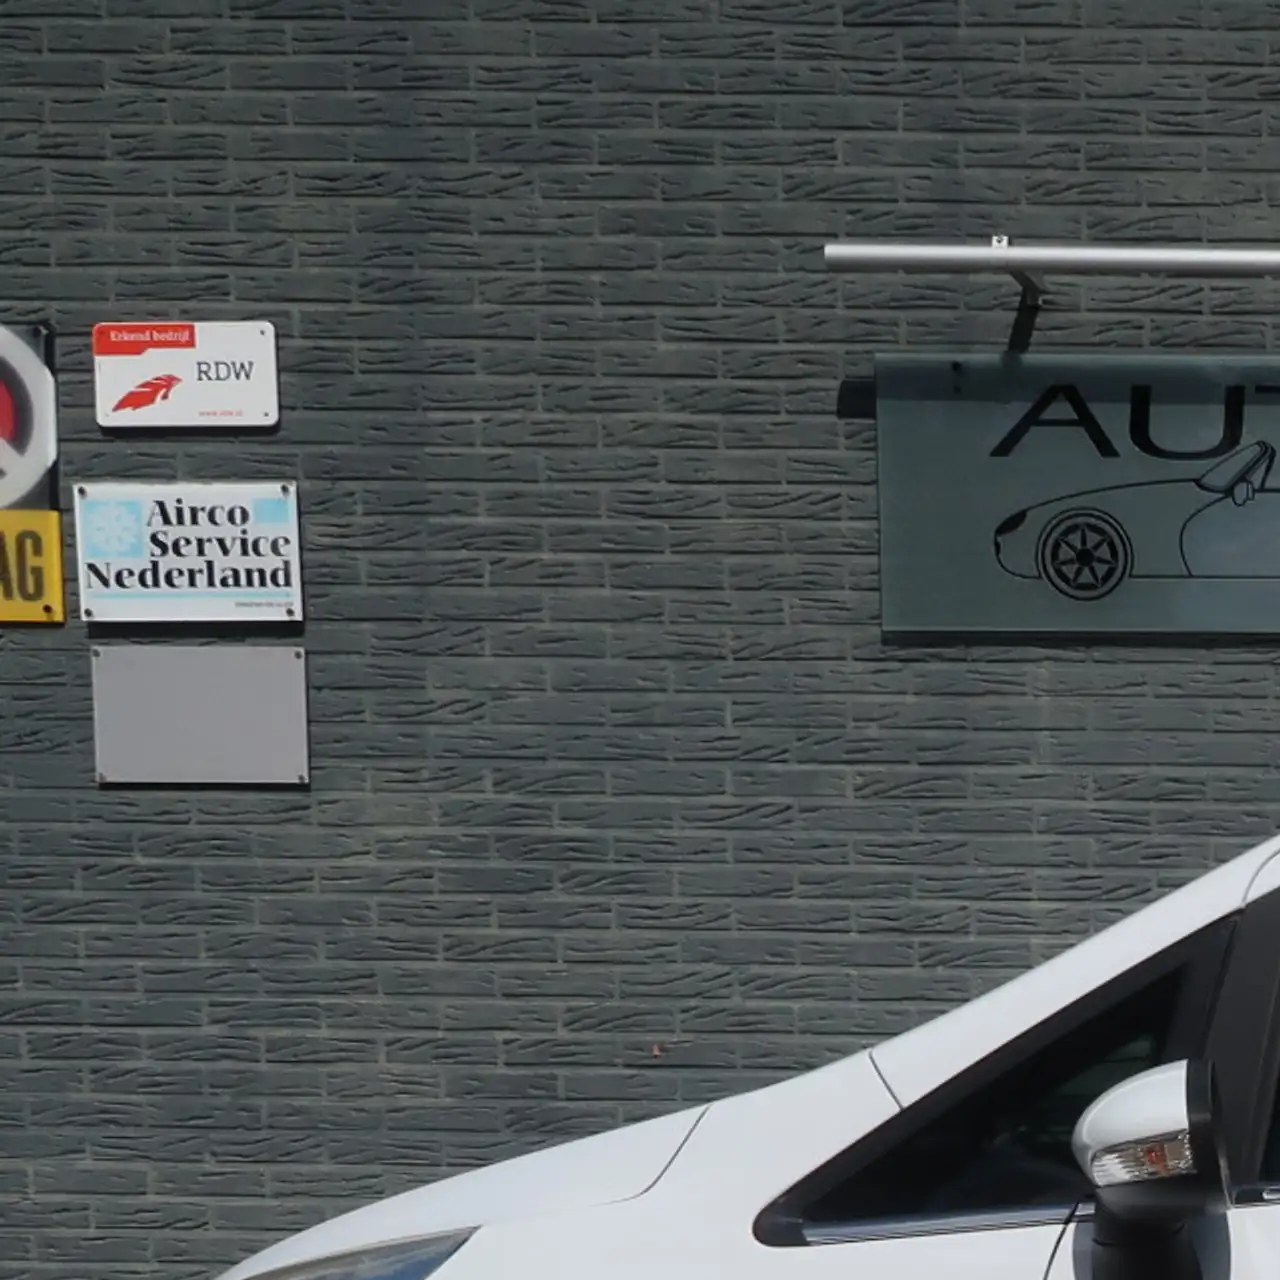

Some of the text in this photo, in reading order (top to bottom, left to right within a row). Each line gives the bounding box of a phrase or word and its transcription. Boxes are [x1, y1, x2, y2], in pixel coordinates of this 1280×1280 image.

[196, 361, 254, 382] RDW
[146, 498, 250, 527] Airco
[149, 529, 291, 558] Service
[85, 560, 293, 590] Nederland
